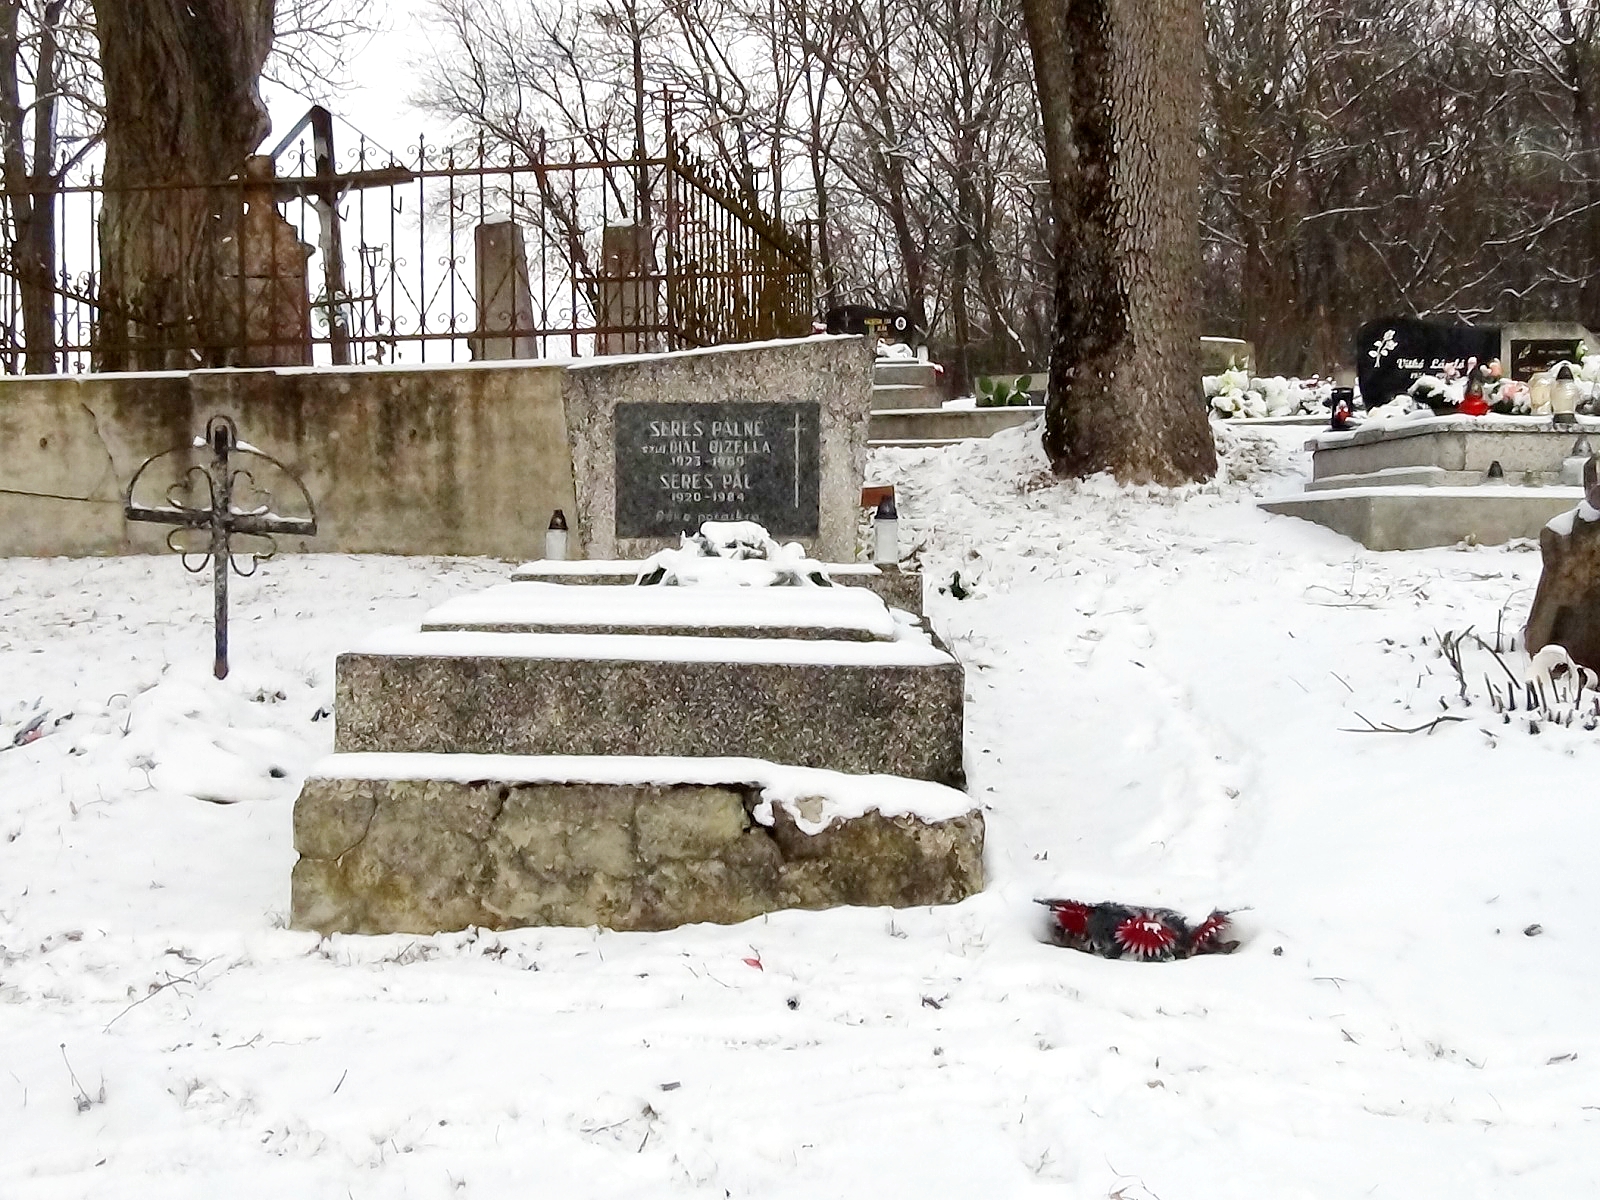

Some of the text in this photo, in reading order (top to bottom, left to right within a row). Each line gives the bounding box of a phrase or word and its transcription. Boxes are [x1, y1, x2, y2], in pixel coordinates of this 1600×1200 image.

[649, 420, 704, 437] SERES
[709, 440, 771, 454] GIZELLA
[660, 470, 752, 489] SERES PÁL
